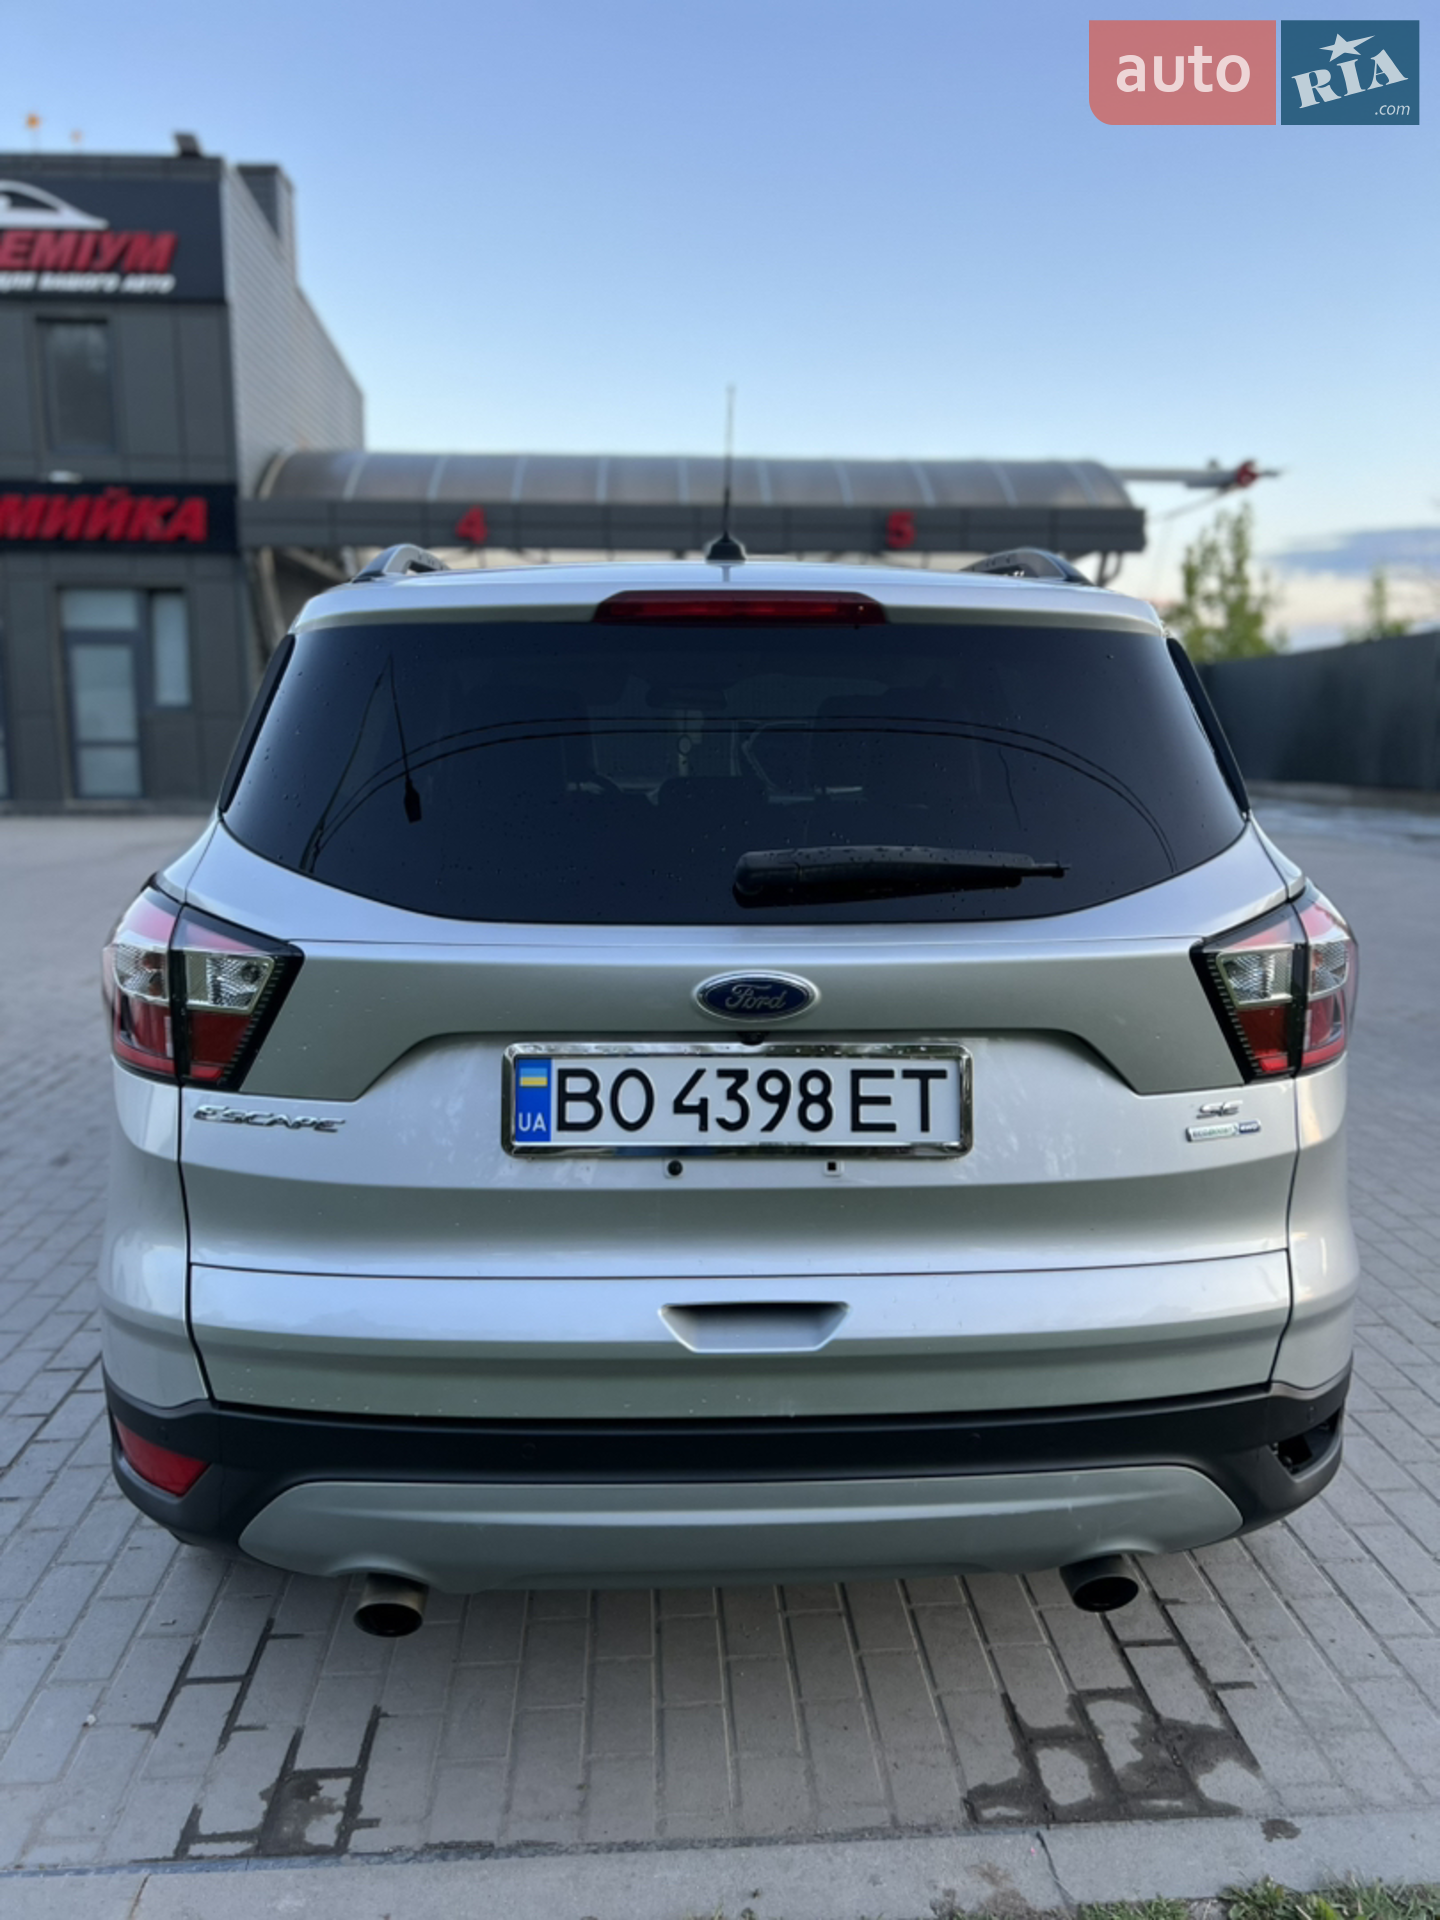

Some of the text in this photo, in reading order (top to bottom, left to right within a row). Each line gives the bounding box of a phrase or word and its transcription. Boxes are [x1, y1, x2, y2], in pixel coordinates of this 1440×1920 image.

[456, 506, 487, 543] 4
[887, 511, 915, 548] 5
[725, 983, 788, 1010] Ford
[556, 1068, 947, 1133] BO 4398 ET
[193, 1104, 346, 1133] ESCAPE
[518, 1112, 547, 1132] UA
